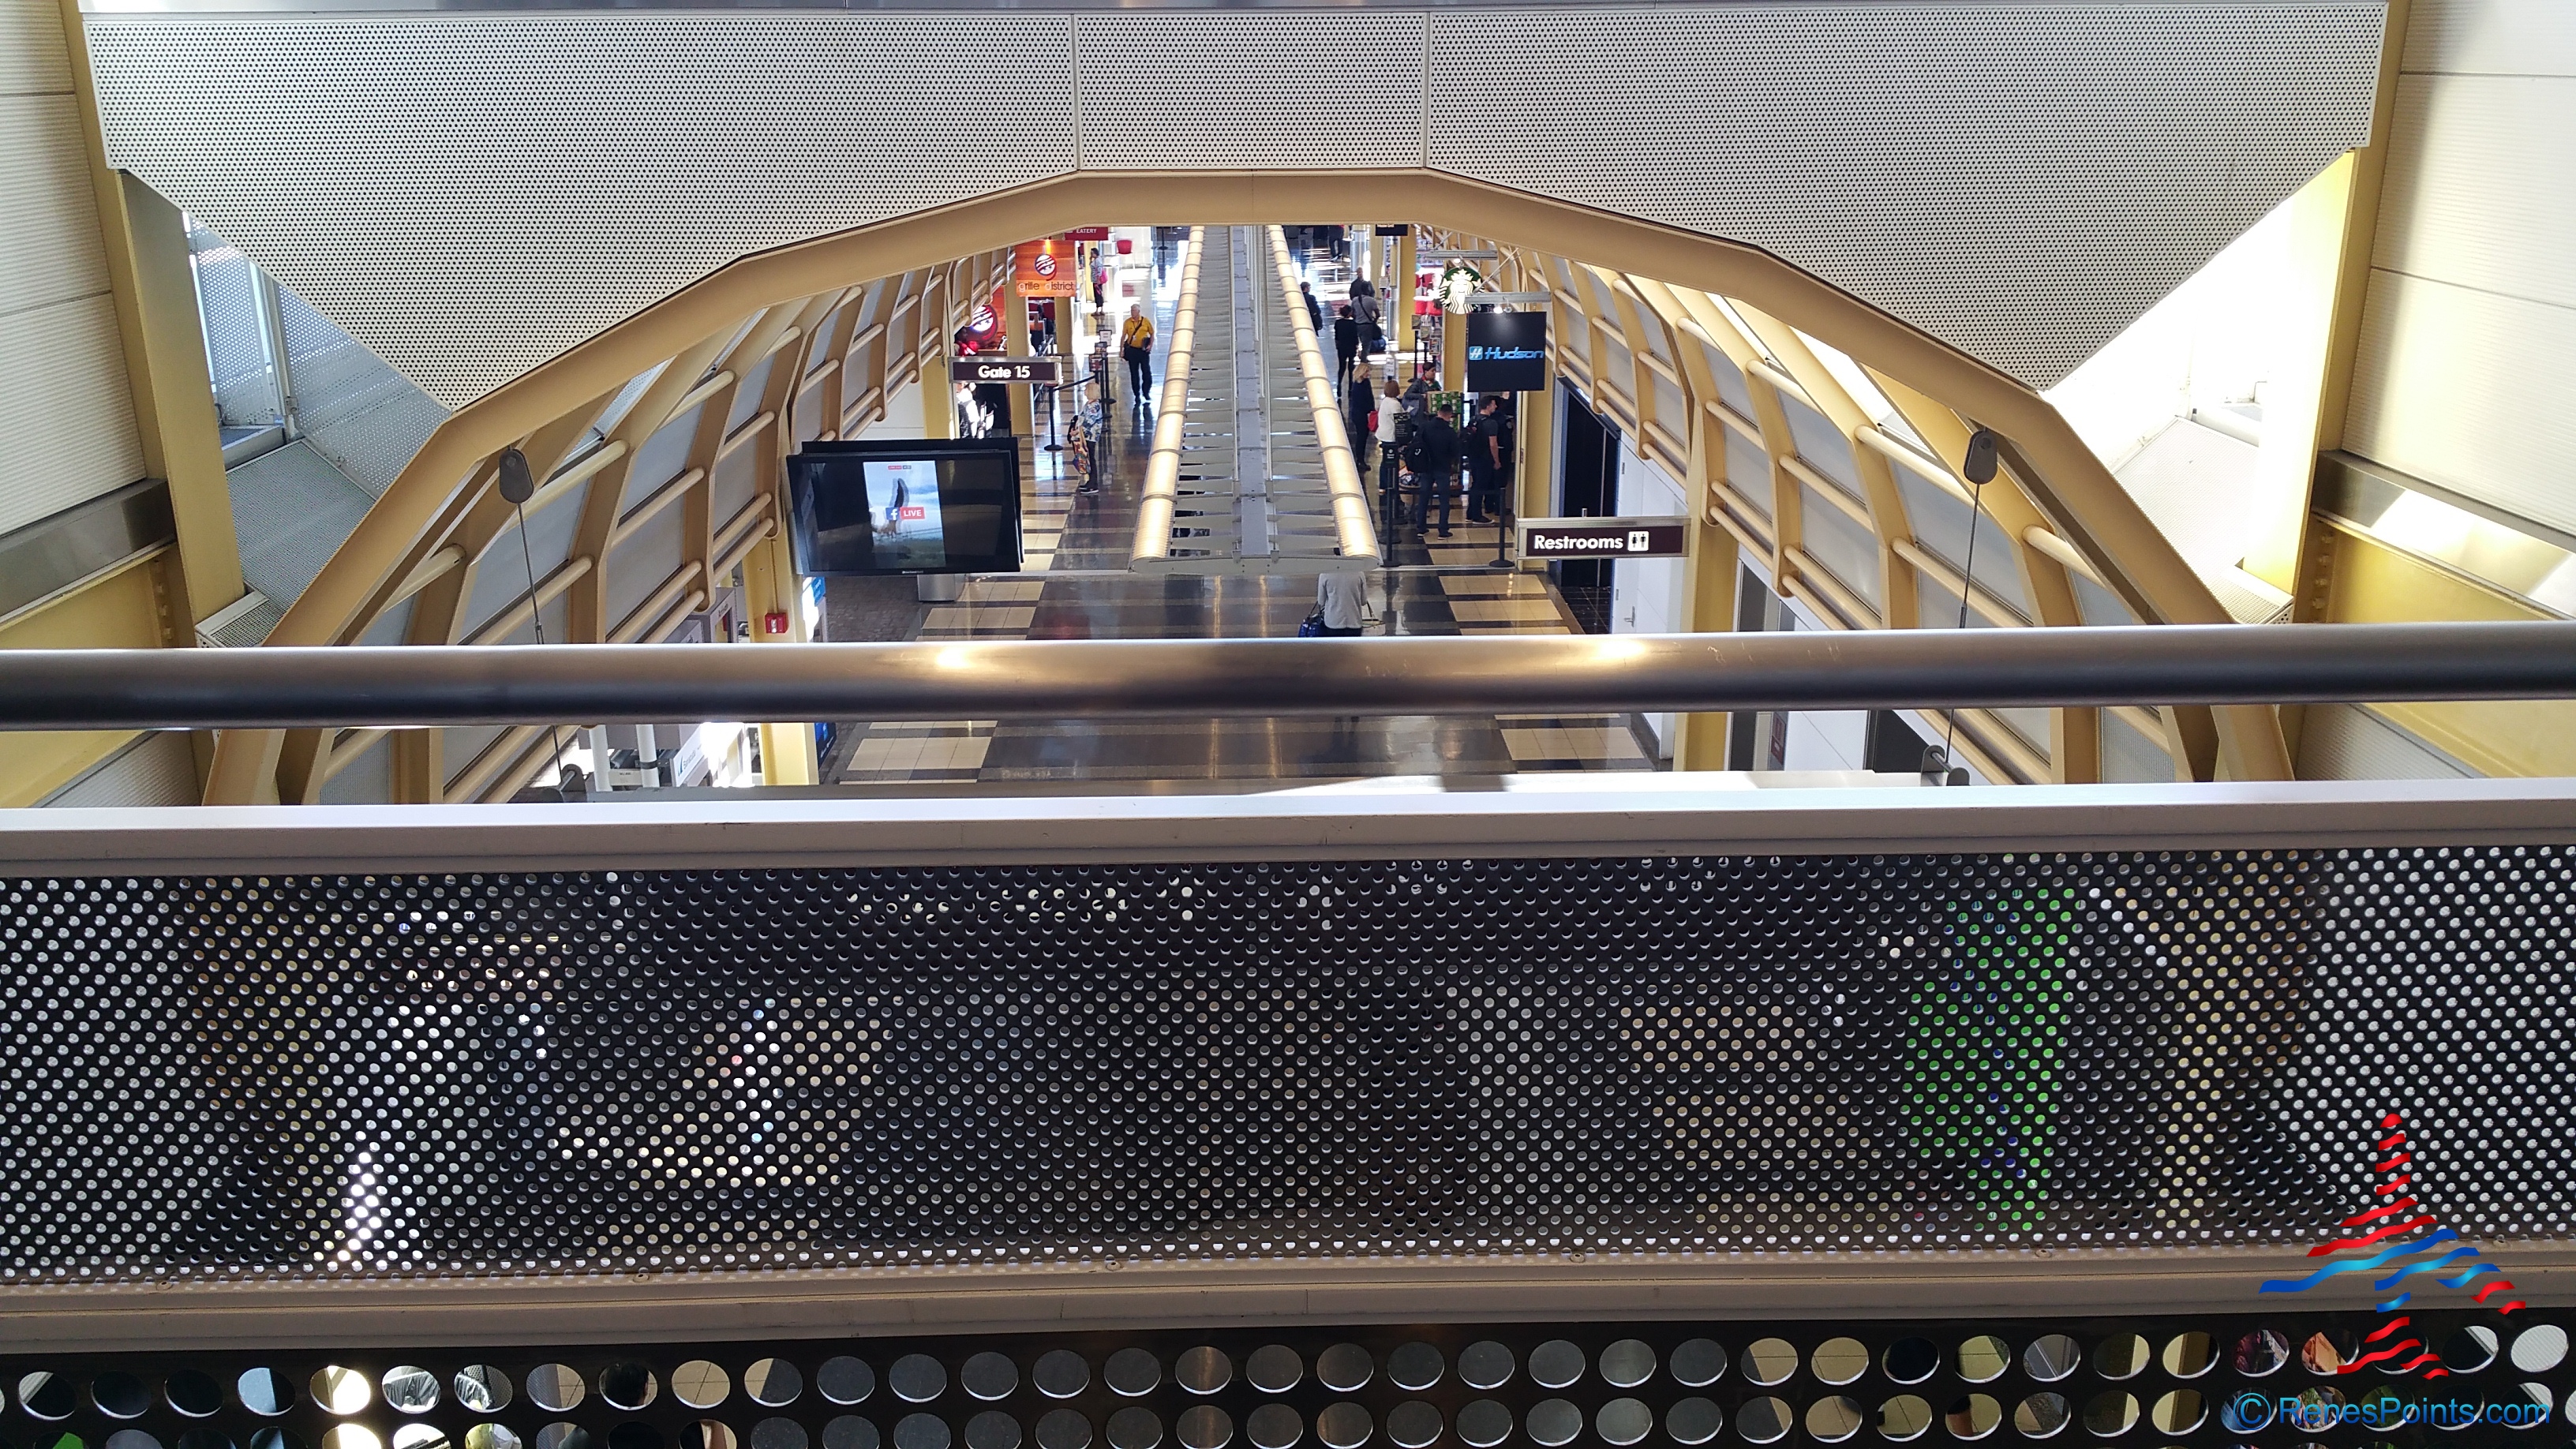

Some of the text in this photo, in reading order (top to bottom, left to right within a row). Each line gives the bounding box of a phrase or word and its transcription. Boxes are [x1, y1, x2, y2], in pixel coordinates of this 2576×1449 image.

[1018, 281, 1074, 293] grille district
[1485, 346, 1544, 360] Hudson
[978, 365, 1031, 379] Gate 15
[1533, 534, 1623, 549] Restrooms
